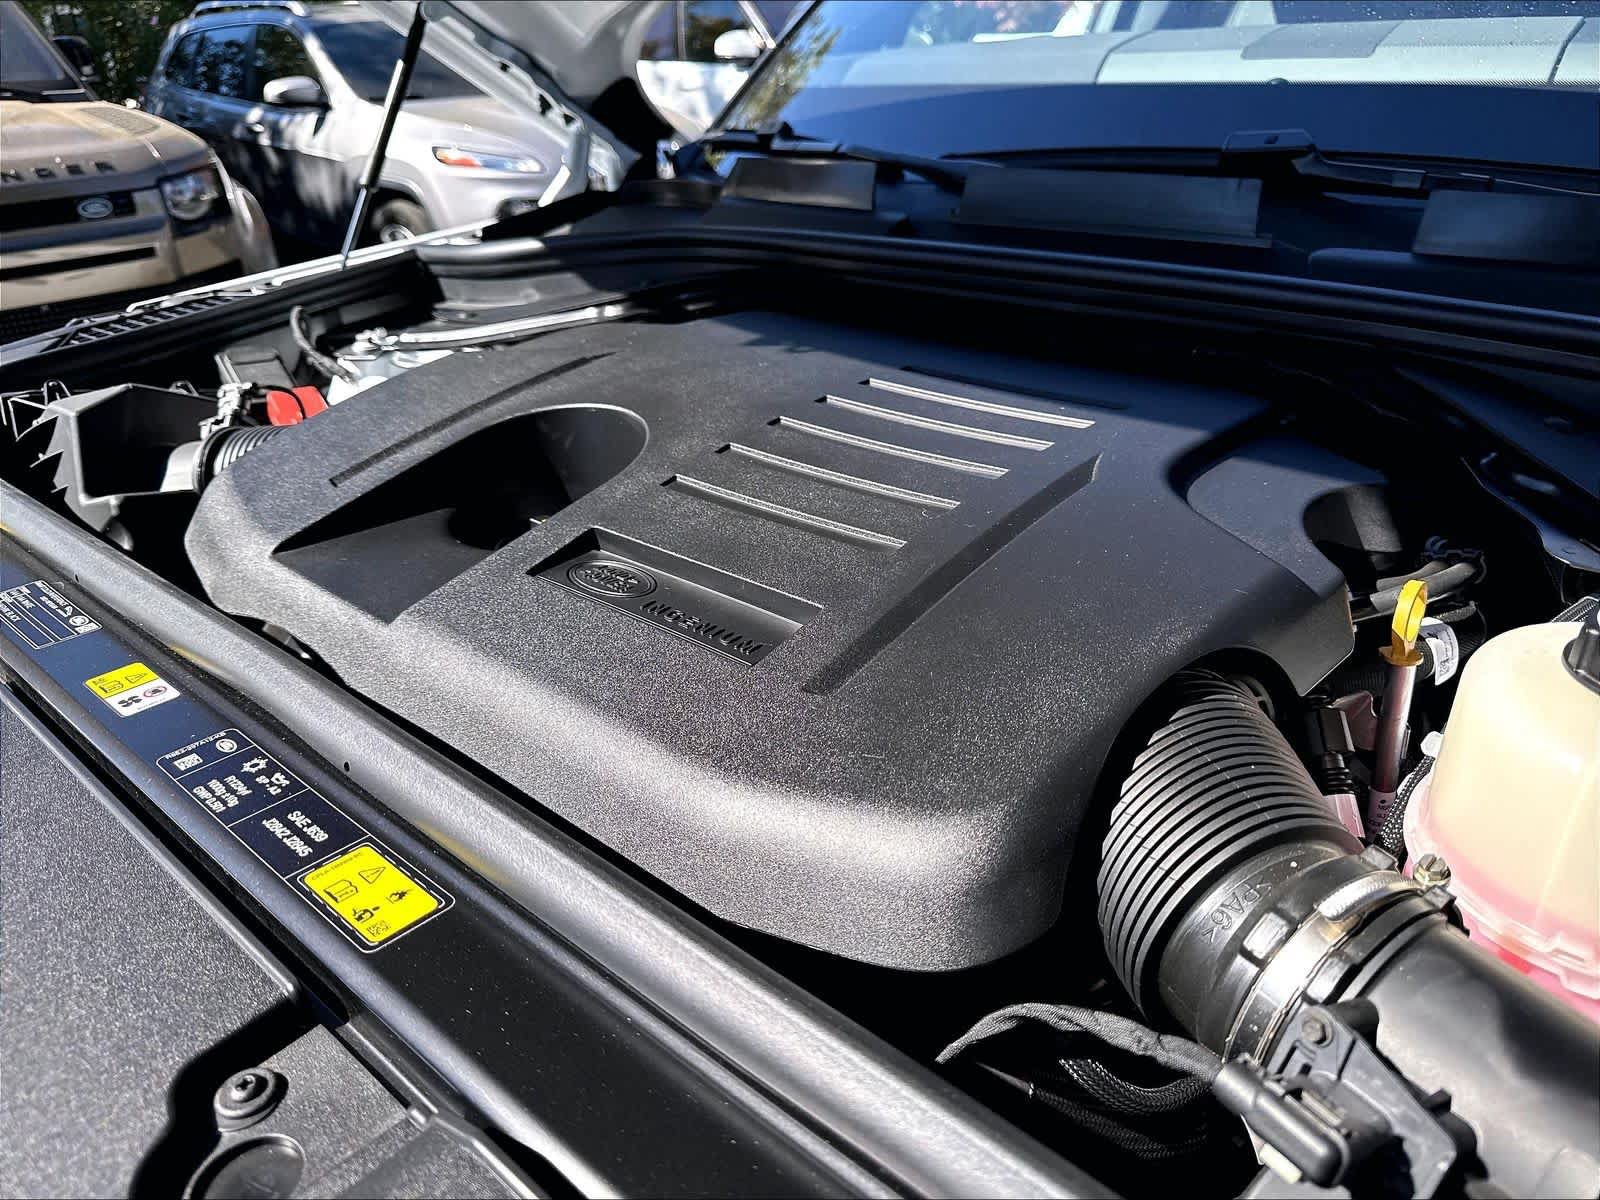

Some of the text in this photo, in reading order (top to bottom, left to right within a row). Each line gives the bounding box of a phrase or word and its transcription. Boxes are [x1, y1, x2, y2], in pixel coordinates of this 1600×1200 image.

[640, 600, 764, 655] INGENIUM
[262, 818, 313, 857] J2842 J2845
[287, 811, 328, 842] SAE J639
